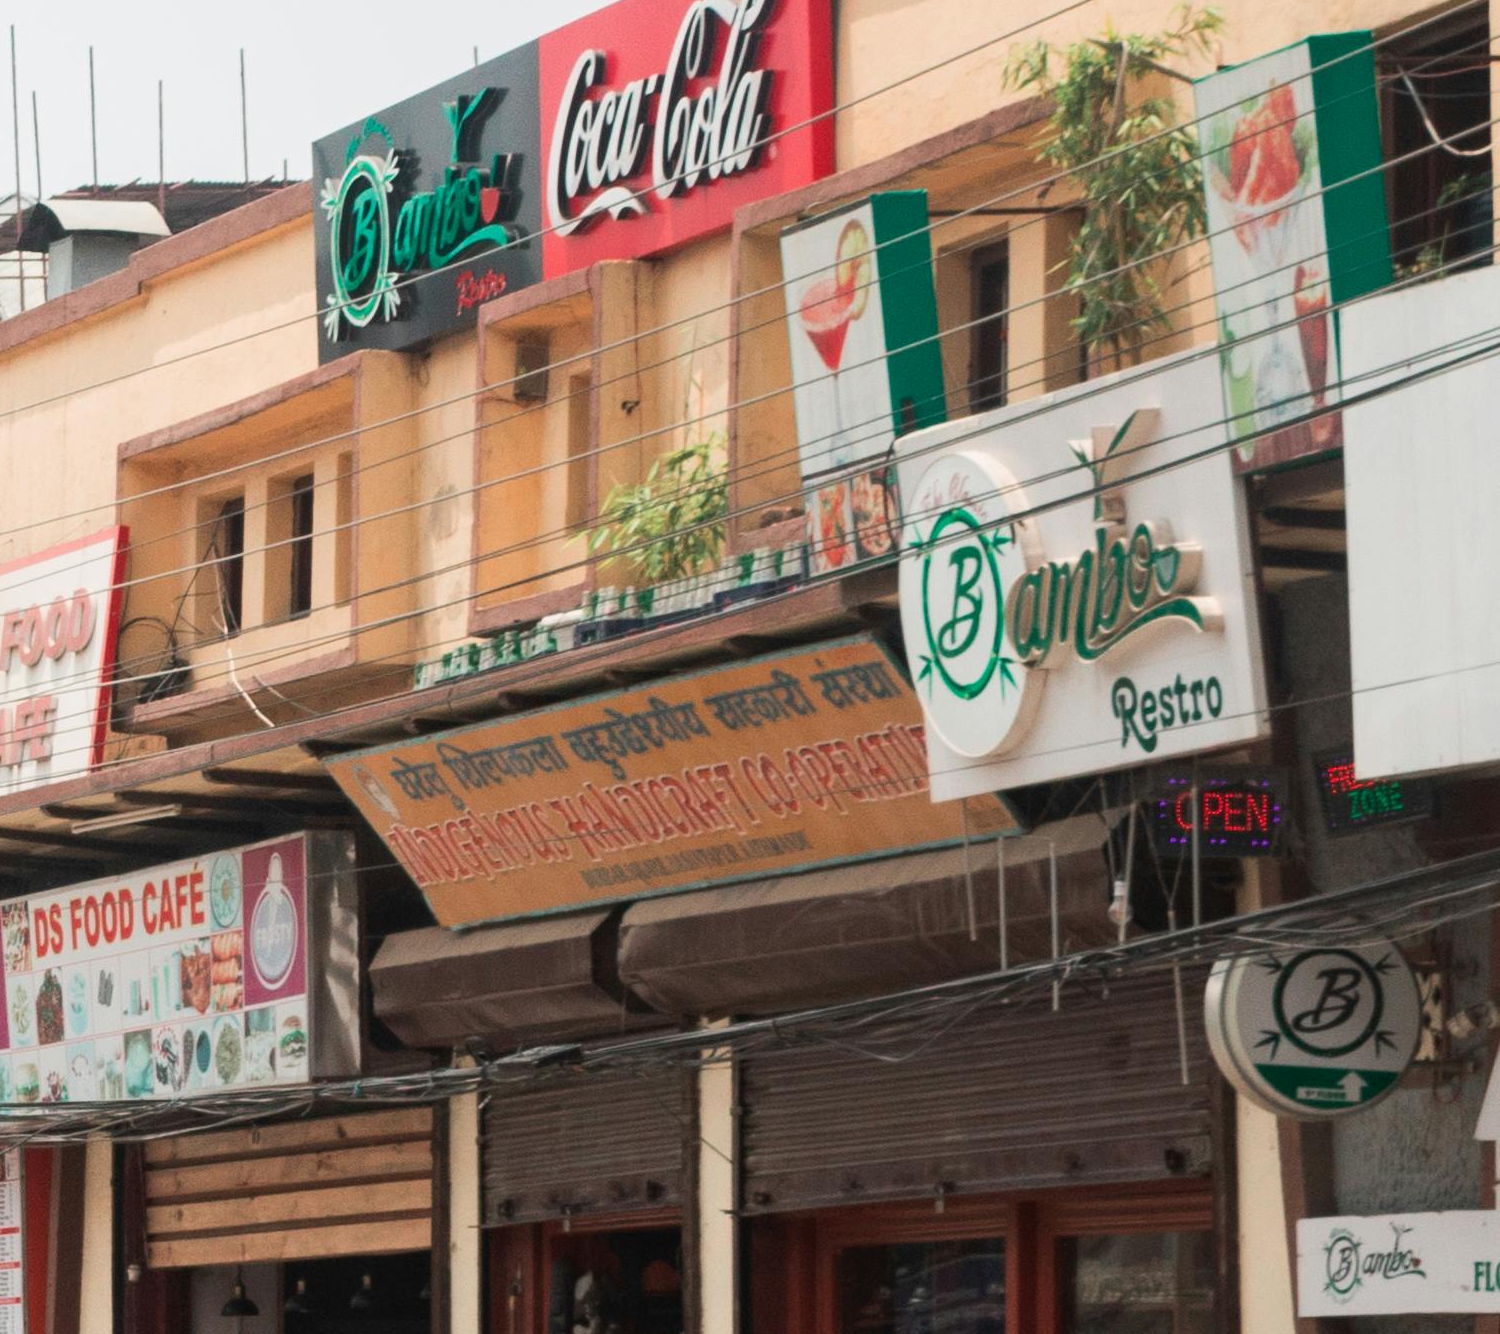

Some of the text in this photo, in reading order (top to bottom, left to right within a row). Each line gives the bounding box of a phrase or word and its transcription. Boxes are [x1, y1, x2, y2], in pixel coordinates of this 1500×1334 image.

[0, 588, 94, 672] FOOD
[1112, 673, 1222, 753] Restro
[387, 798, 572, 887] INDIGENOUS
[555, 759, 758, 863] HANDICRAFT
[1175, 791, 1268, 832] OPEN
[1350, 782, 1404, 819] ZONE
[34, 862, 205, 959] DS FOOD CAFÉ
